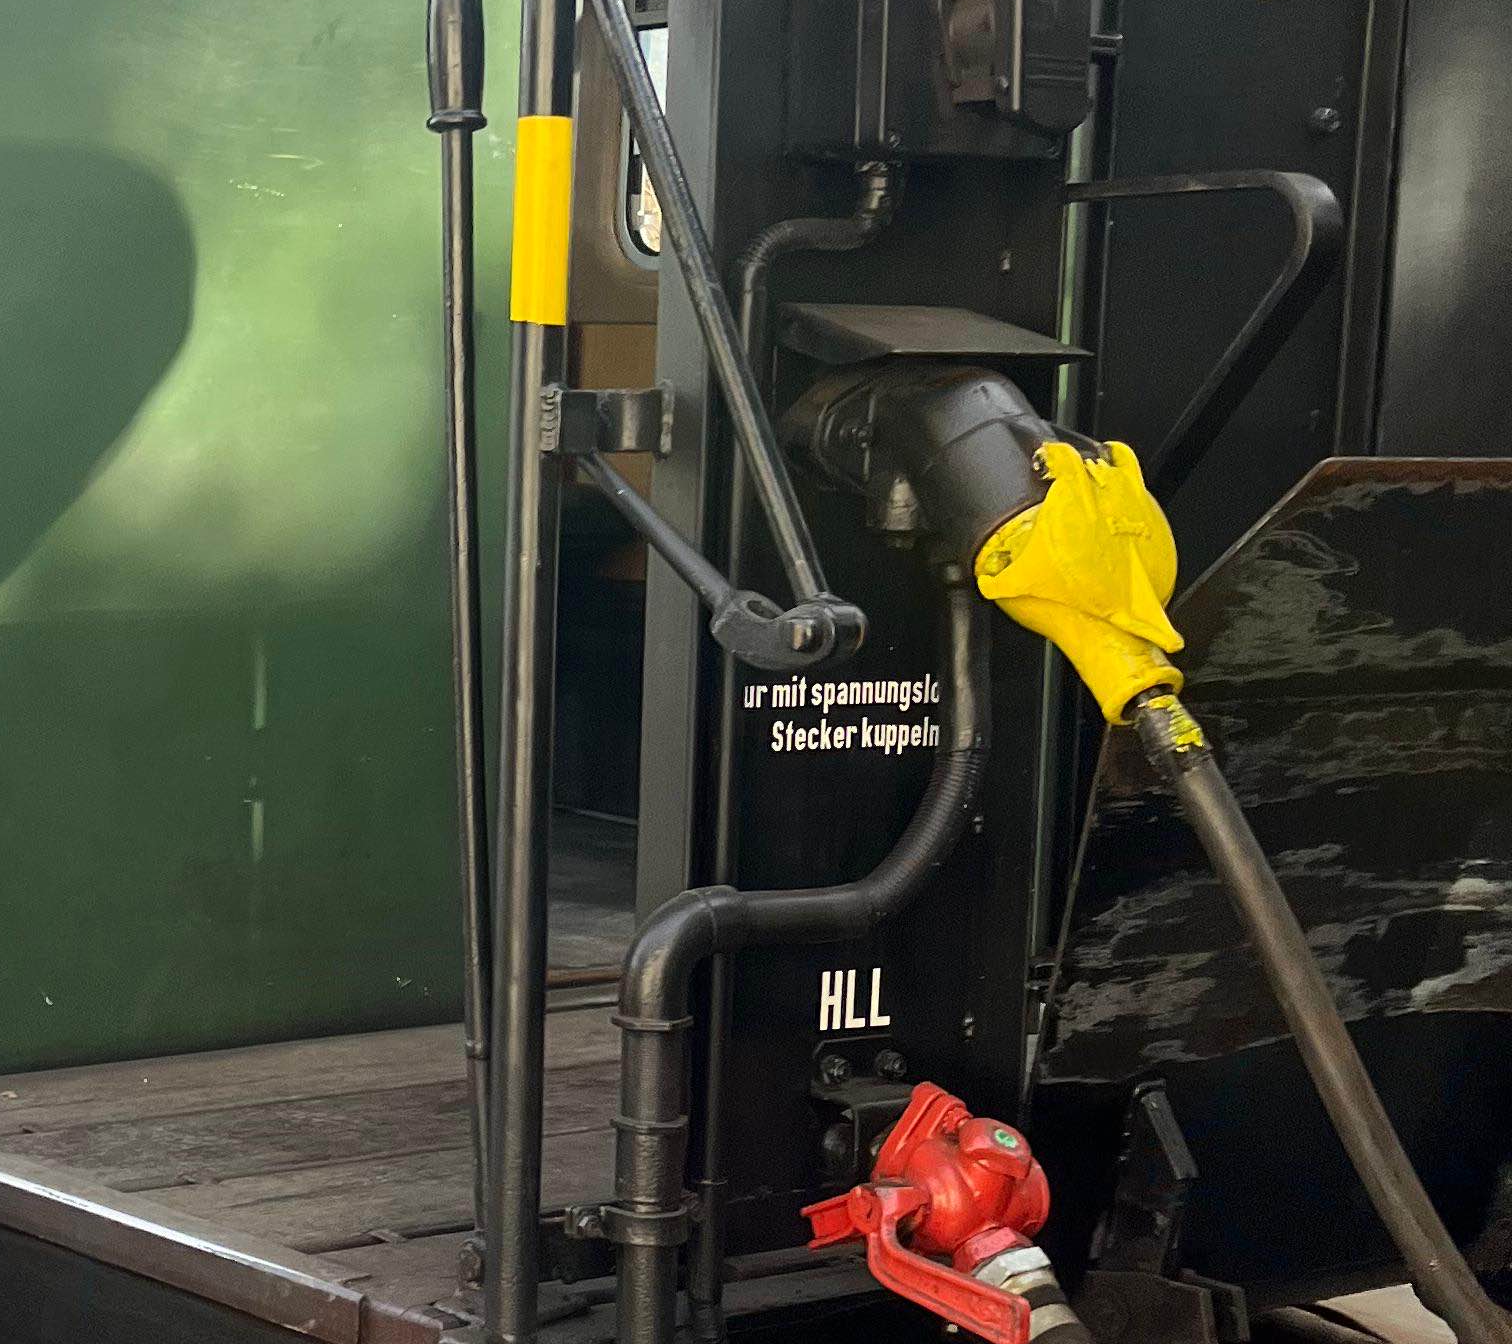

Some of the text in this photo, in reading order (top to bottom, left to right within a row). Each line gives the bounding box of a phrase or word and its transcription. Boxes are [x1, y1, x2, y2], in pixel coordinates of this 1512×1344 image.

[772, 675, 807, 708] mit
[771, 716, 940, 755] Stecker kuppeln
[819, 968, 890, 1030] HLL
